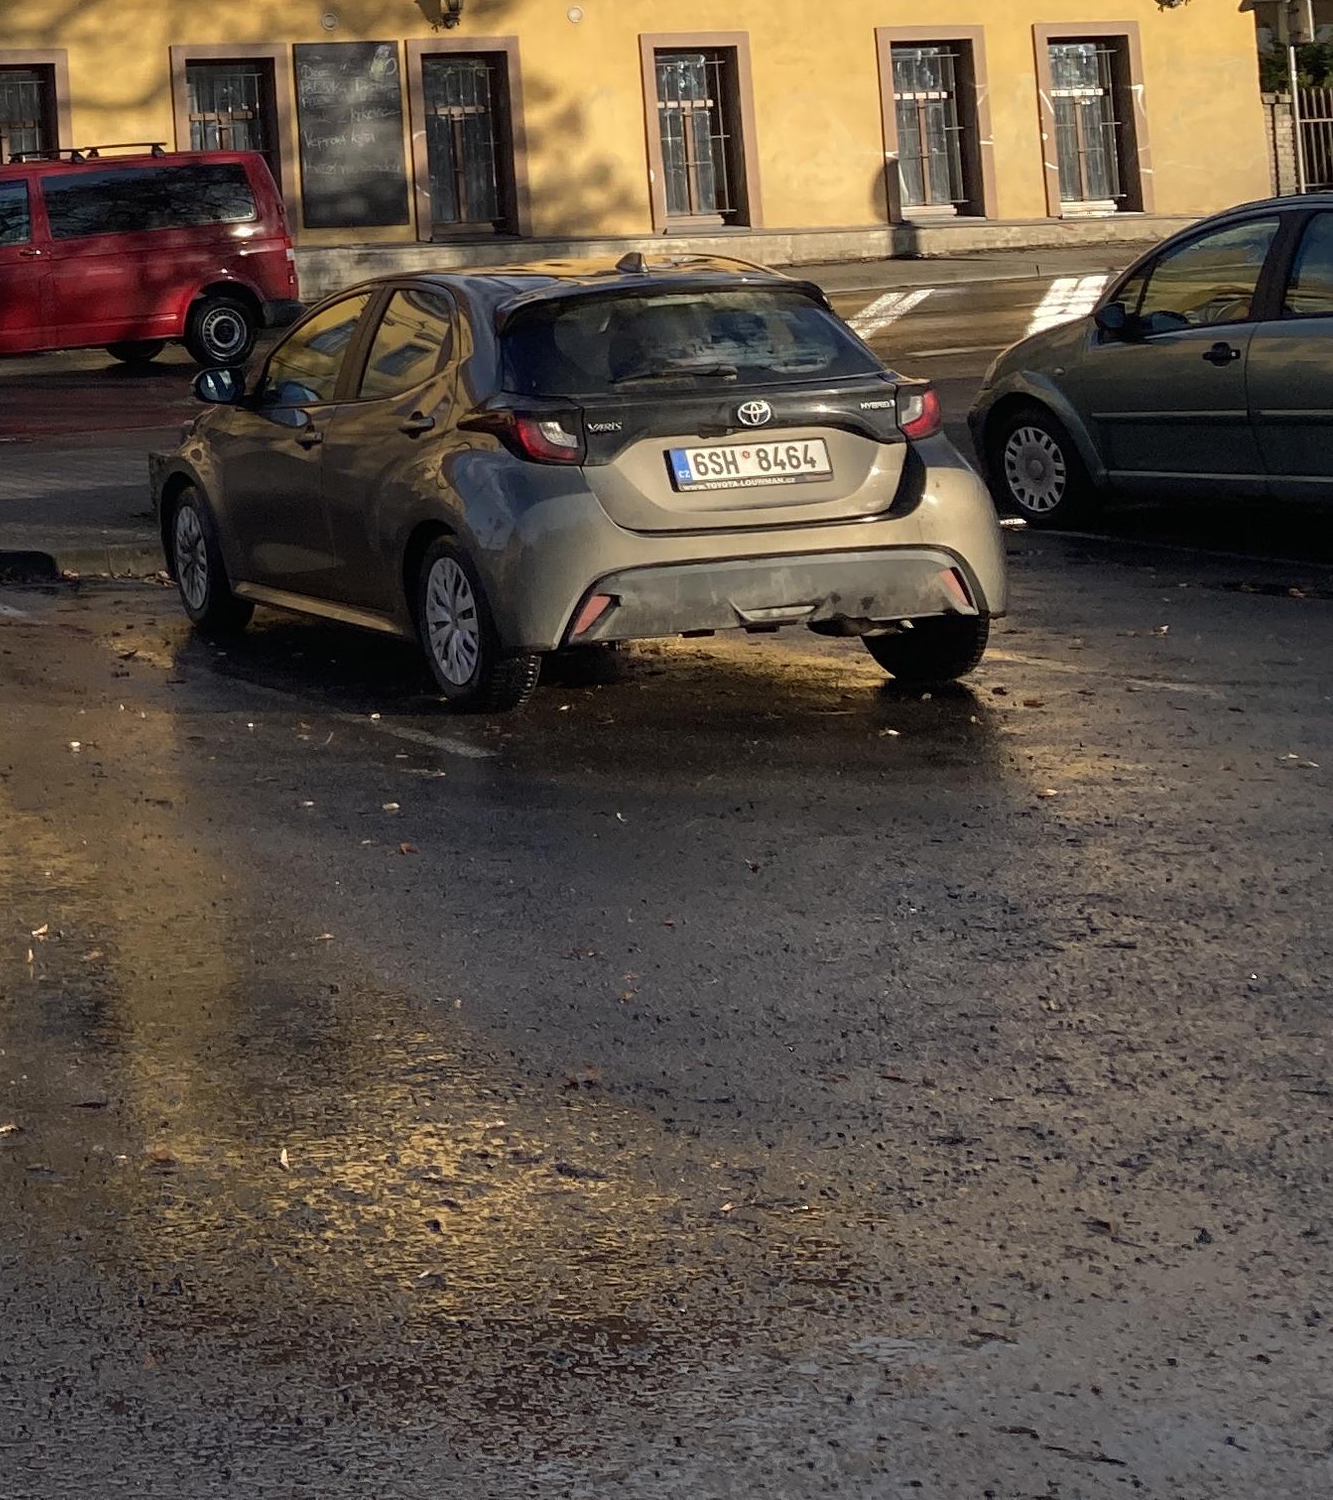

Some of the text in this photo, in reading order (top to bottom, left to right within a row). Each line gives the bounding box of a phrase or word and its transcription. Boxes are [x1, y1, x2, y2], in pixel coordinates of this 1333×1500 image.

[587, 421, 623, 433] YARIS
[692, 444, 817, 477] 6SH 8464
[678, 470, 691, 479] CZ
